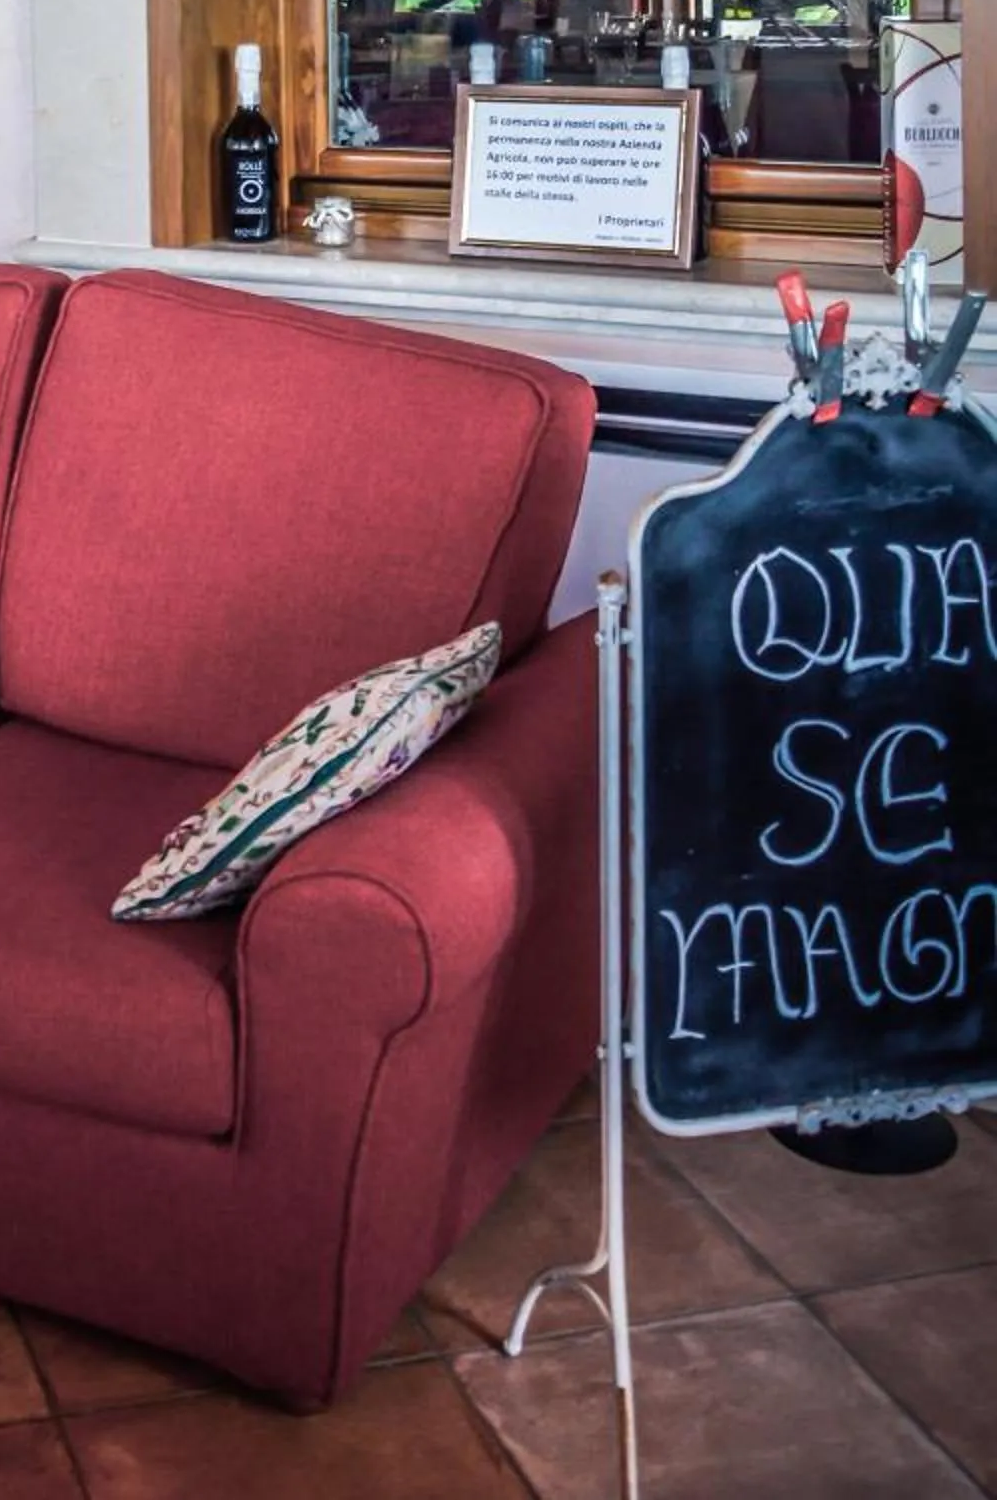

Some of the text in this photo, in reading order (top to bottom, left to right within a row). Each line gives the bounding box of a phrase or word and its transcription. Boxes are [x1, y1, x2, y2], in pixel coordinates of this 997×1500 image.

[501, 117, 550, 128] comunica
[553, 117, 562, 128] ai
[565, 118, 596, 129] nostri
[634, 121, 652, 132] che
[655, 122, 666, 132] la
[904, 127, 960, 142] BERLUCCH
[488, 135, 663, 150] permanenza nella nostra Azienda
[534, 155, 554, 164] non
[556, 156, 578, 167] può
[580, 157, 627, 168] superare
[630, 158, 640, 168] le
[642, 160, 661, 169] ore
[517, 173, 534, 183] per
[537, 173, 570, 184] motivi
[573, 173, 583, 185] di
[585, 175, 619, 186] lavoro
[622, 176, 648, 187] nelle
[514, 189, 539, 200] della
[604, 215, 665, 228] Proprietari
[732, 539, 997, 681] QUA
[759, 718, 954, 866] SE
